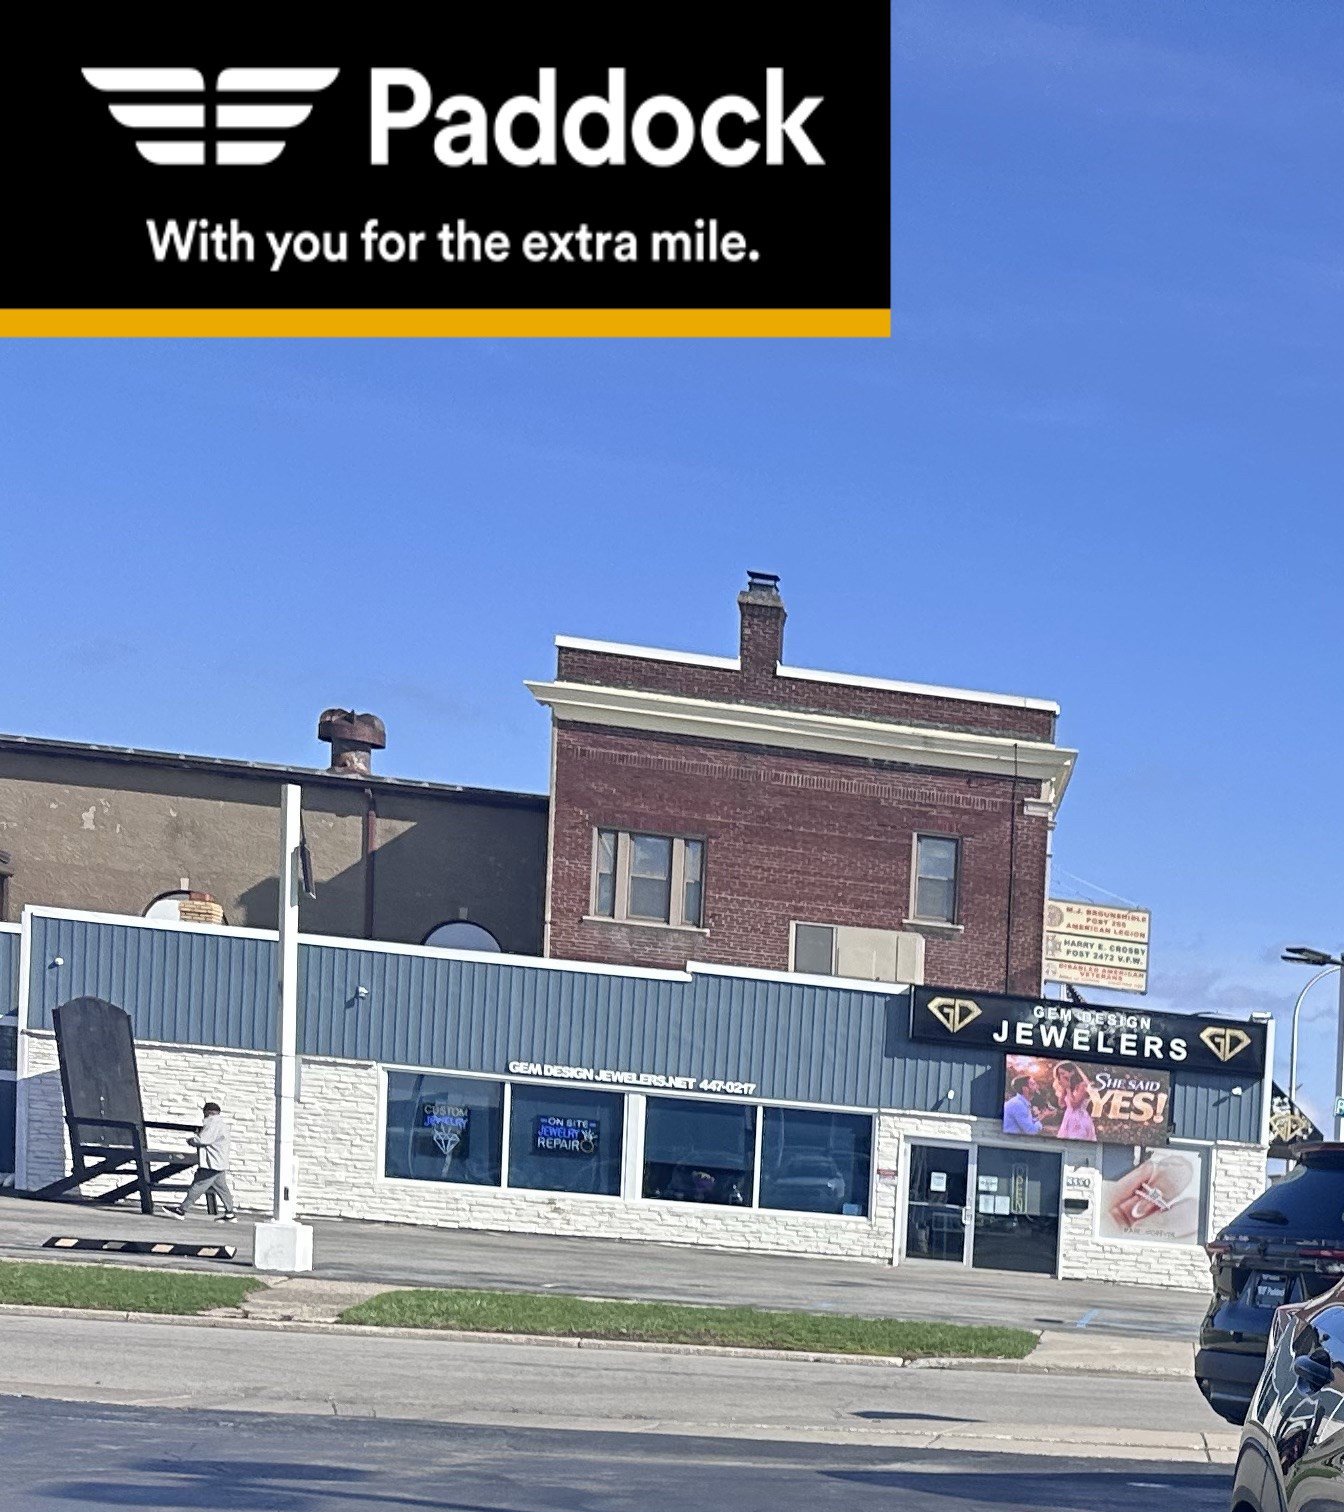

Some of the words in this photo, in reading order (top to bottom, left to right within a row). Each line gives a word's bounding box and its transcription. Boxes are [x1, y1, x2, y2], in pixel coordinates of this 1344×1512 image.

[1086, 917, 1108, 925] POST
[1066, 923, 1111, 933] AMERICAN
[1114, 929, 1146, 939] LEGION
[1064, 939, 1095, 950] HARRY
[1109, 945, 1146, 956] CROSBY
[1066, 949, 1090, 958] POST
[1059, 963, 1099, 974] DISABLED
[1102, 968, 1144, 979] AMERICAN
[1080, 971, 1123, 981] VETERANS
[1034, 1005, 1073, 1022] GEM
[1082, 1008, 1152, 1030] DESIGN
[993, 1020, 1189, 1061] JEWELERS
[508, 1061, 543, 1076] GEM
[543, 1064, 595, 1081] DESIGN
[594, 1070, 697, 1089] JEWELERS.NET
[699, 1080, 757, 1095] 447-0217
[1126, 1078, 1160, 1092] SAID
[424, 1104, 468, 1117] CUSTOM
[1087, 1091, 1168, 1125] YES!
[424, 1116, 467, 1129] JEWELRY
[548, 1117, 564, 1127] ON
[566, 1117, 589, 1129] SITE
[538, 1124, 580, 1139] JEWELRY
[537, 1136, 580, 1151] REPAIR
